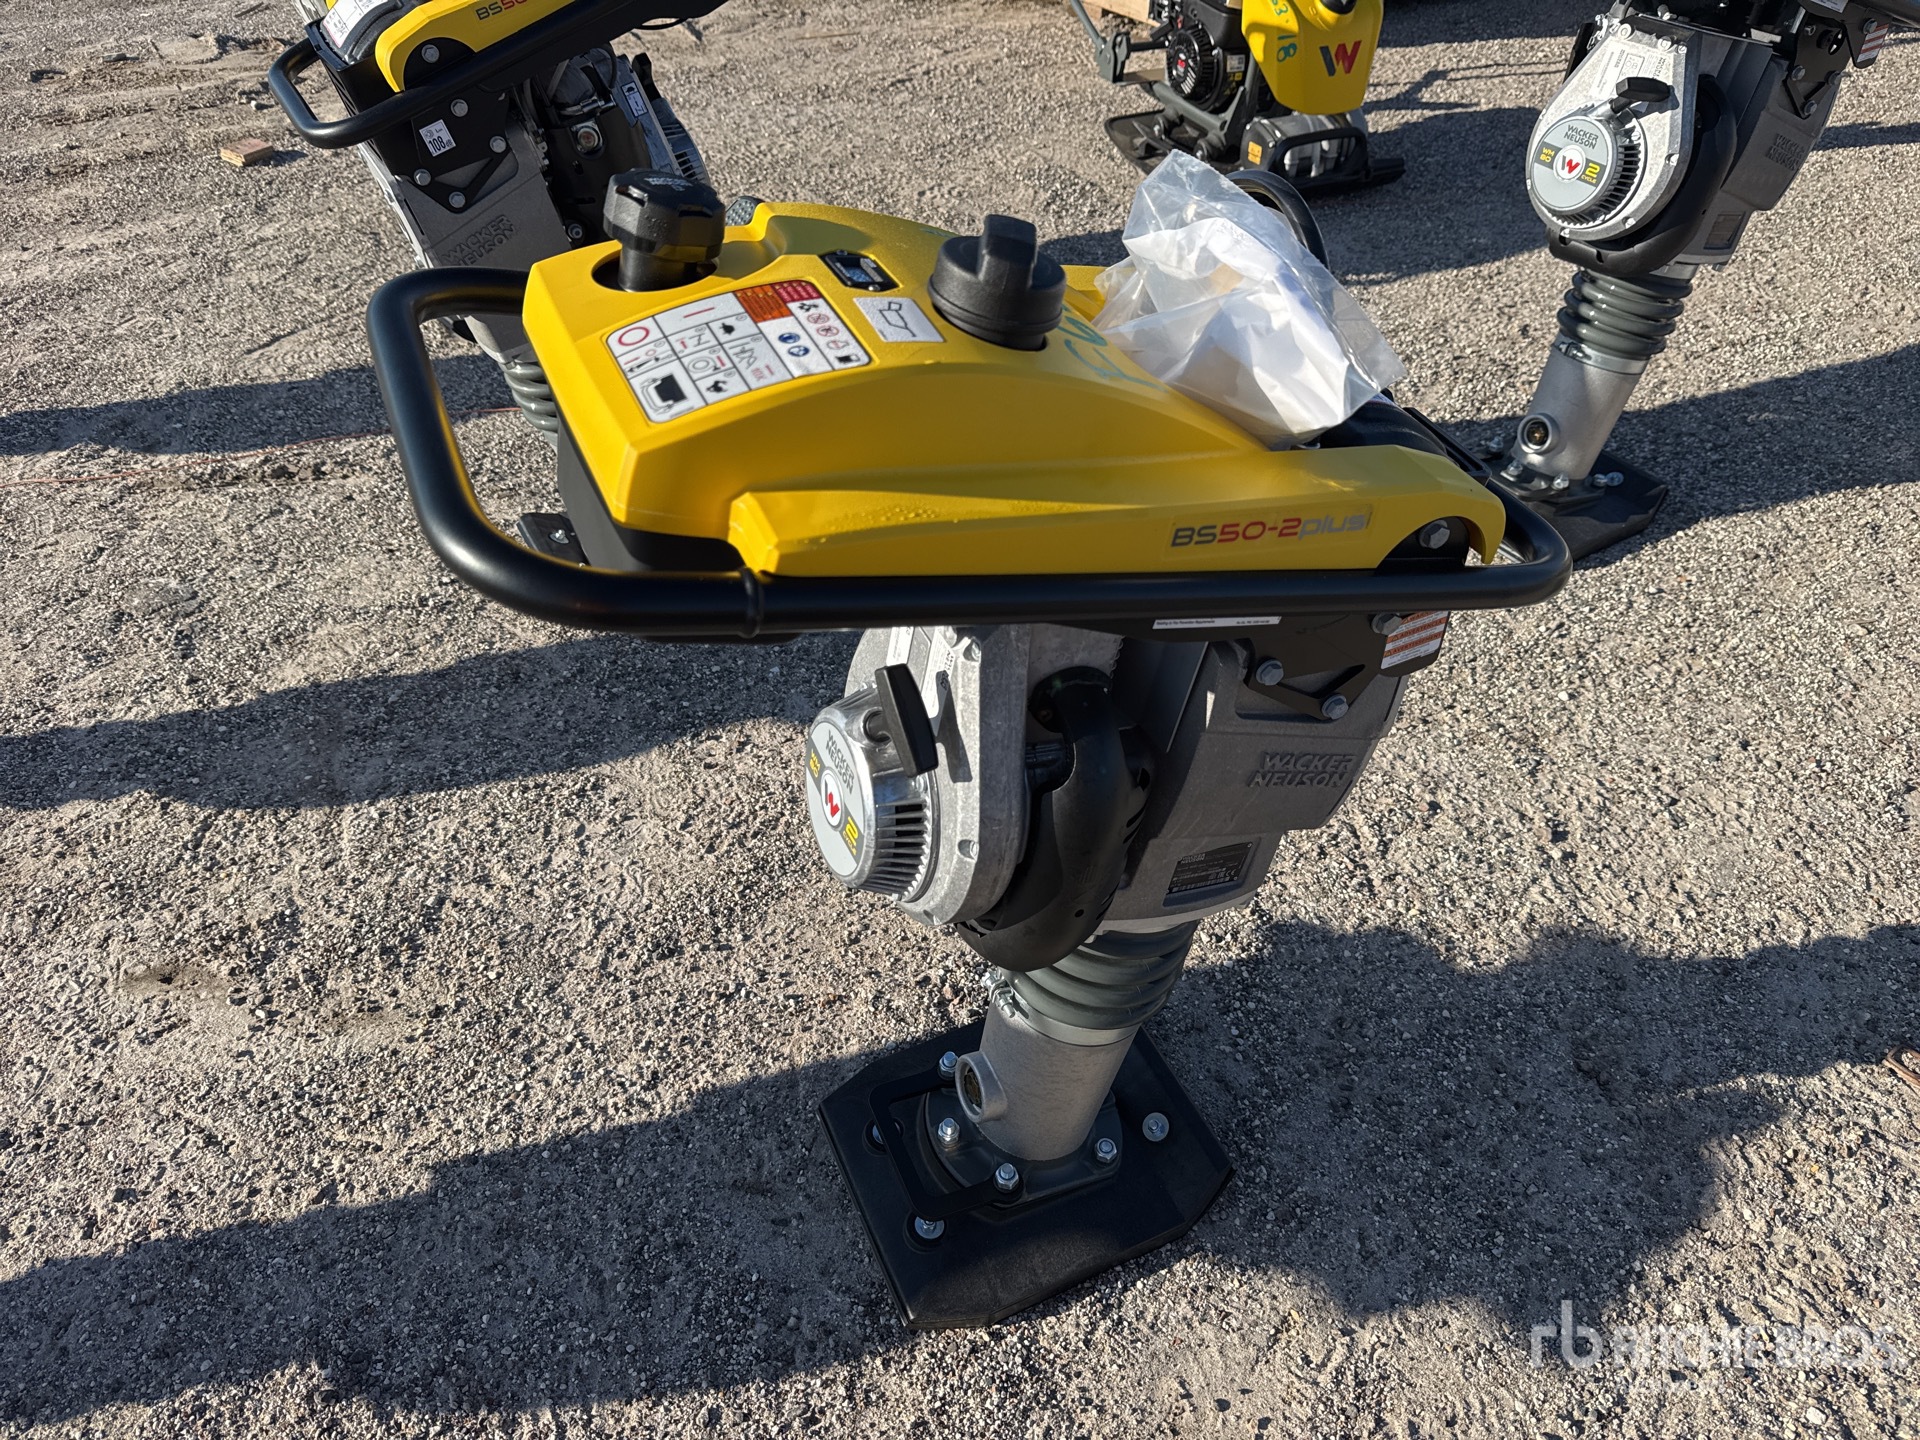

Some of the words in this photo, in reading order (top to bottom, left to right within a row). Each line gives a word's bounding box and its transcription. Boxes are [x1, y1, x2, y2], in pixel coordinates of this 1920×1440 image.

[1564, 132, 1597, 149] NEUSON
[1568, 125, 1599, 142] WACKER
[429, 135, 446, 153] 108
[1585, 163, 1600, 178] 2
[441, 213, 512, 261] WACKER
[1171, 515, 1367, 547] BS50-2plus
[828, 729, 855, 782] WACKER
[1261, 752, 1357, 772] WACKER
[825, 740, 854, 795] NEUSON
[1248, 769, 1350, 788] NEUSON
[845, 816, 858, 847] 2
